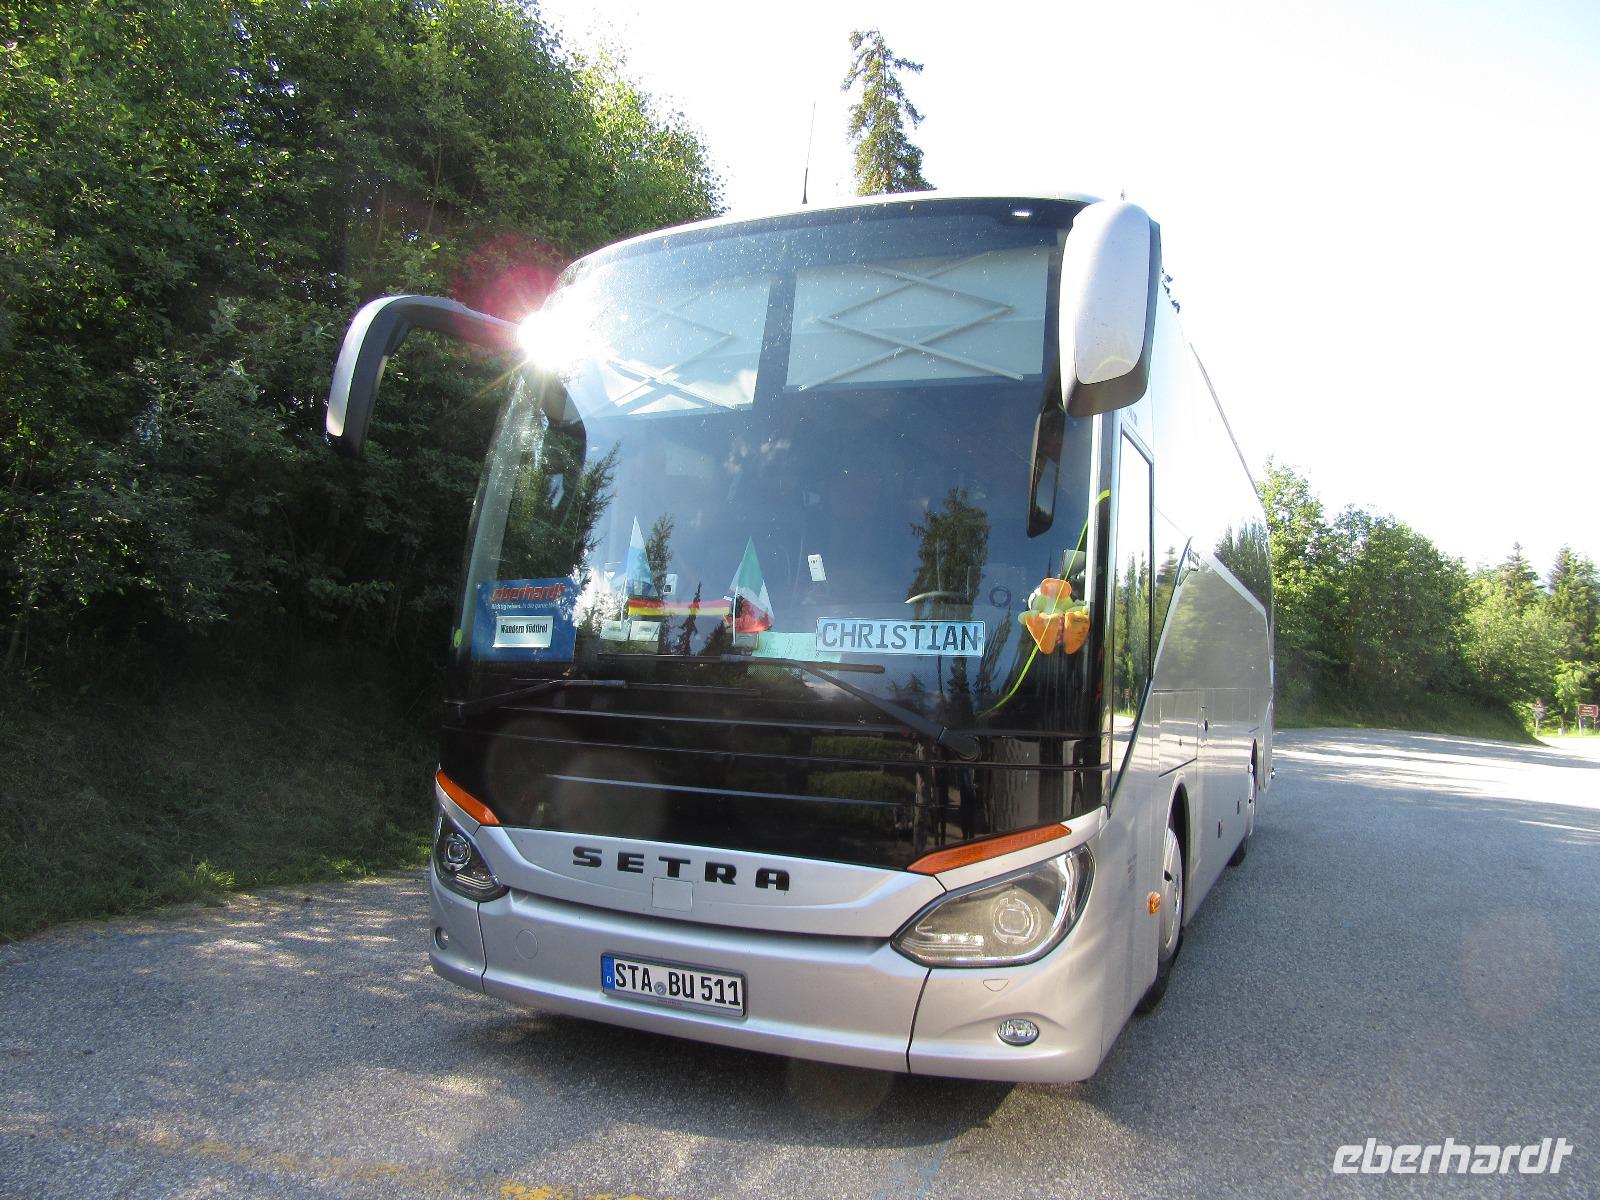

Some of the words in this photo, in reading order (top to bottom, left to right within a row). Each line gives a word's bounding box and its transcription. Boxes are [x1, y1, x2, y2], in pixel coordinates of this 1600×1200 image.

[500, 624, 525, 634] Wandern
[525, 623, 548, 634] Südtirol
[822, 622, 979, 651] CHRISTIAN
[573, 846, 790, 891] SETRA
[615, 962, 653, 993] STA
[668, 971, 696, 1000] BU
[700, 976, 741, 1006] 511
